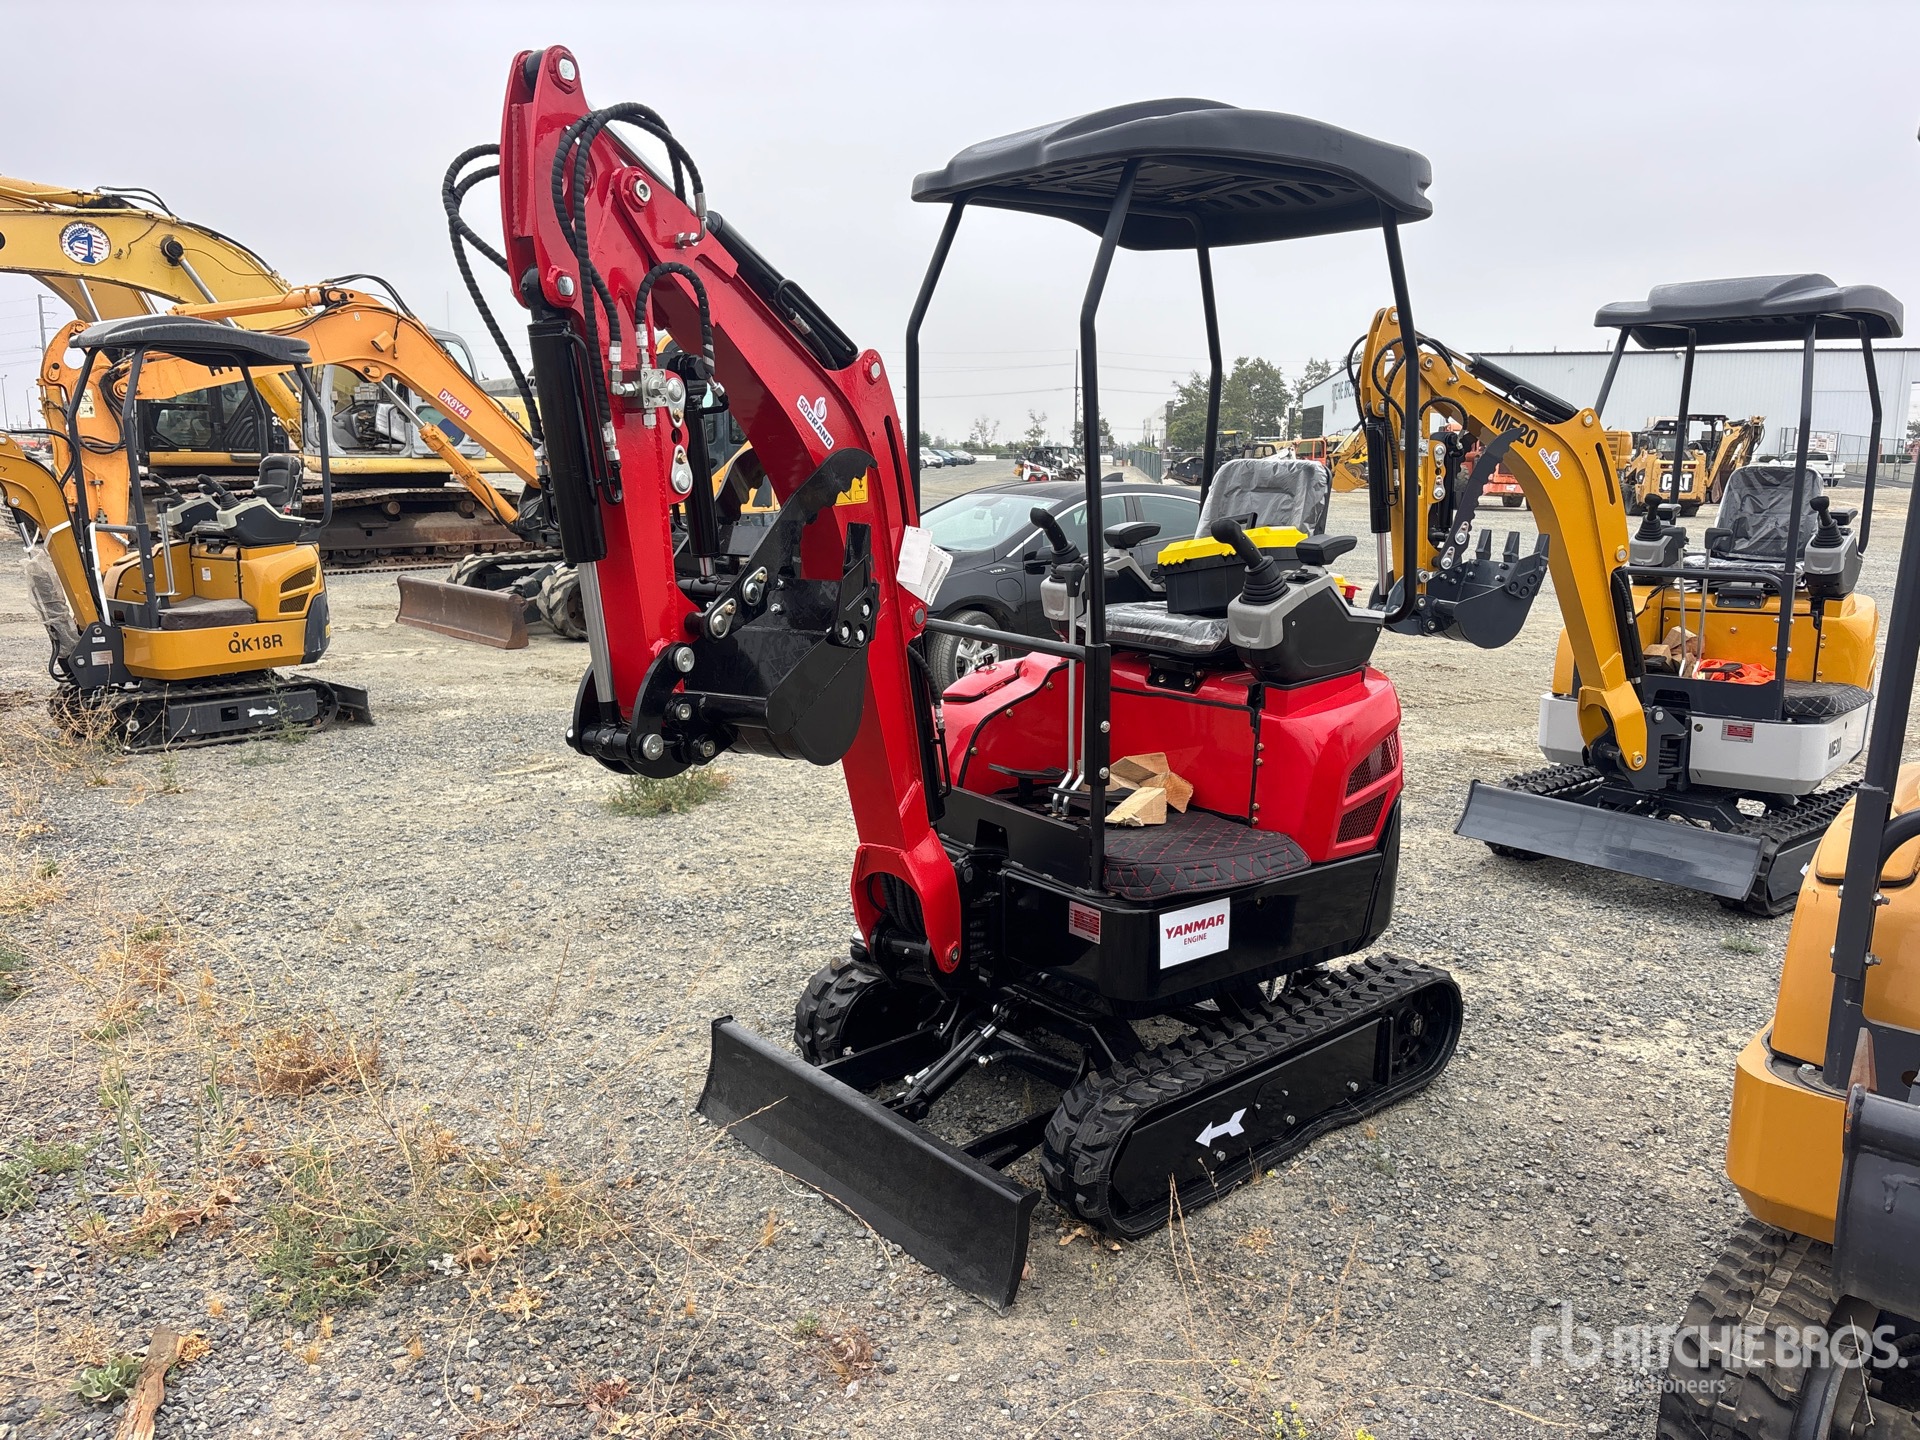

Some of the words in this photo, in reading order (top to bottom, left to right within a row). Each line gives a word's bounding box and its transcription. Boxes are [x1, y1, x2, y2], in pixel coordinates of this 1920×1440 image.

[439, 390, 469, 417] DK8Y44
[798, 398, 833, 447] SOGRAND
[228, 634, 283, 653] QK18R
[1165, 913, 1225, 940] YANMAR
[1184, 933, 1207, 945] ENGINE
